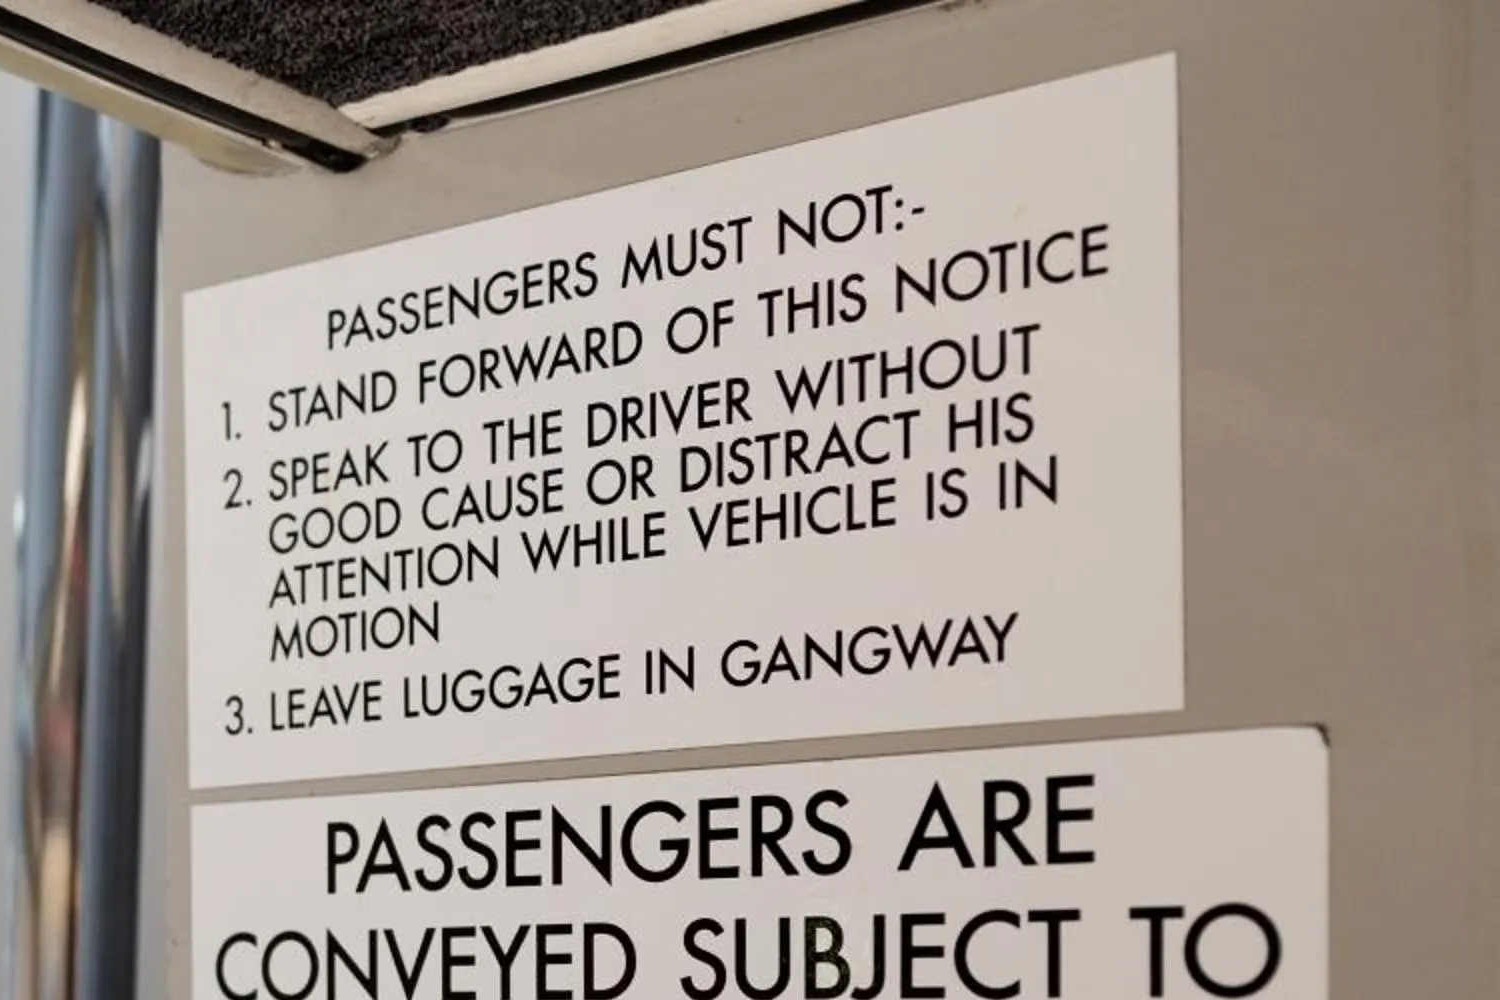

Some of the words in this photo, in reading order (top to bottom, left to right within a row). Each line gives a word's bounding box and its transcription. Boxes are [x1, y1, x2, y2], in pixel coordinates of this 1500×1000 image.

[220, 401, 243, 441] 1.
[267, 369, 398, 433] STAND
[418, 319, 644, 405] FORWARD
[665, 298, 735, 356] OF
[756, 272, 868, 339] THIS
[894, 222, 1110, 314] NOTICE
[327, 250, 600, 351] PASSENGERS
[620, 214, 754, 290] MUST
[777, 183, 926, 256] NOT:-
[222, 467, 253, 510] 2.
[267, 440, 390, 502] SPEAK
[406, 428, 464, 478] TO
[482, 408, 564, 466] THE
[586, 376, 754, 450] DRIVER
[773, 322, 1042, 415] WITHOUT
[268, 496, 402, 556] GOOD
[420, 466, 565, 532] CAUSE
[585, 453, 658, 507] OR
[679, 413, 922, 494] DISTRACT
[947, 390, 1035, 454] HIS
[268, 534, 500, 610] ATTENTION
[519, 510, 667, 574] WHILE
[686, 476, 897, 552] VEHICLE
[925, 466, 970, 522] IS
[998, 454, 1058, 512] IN
[223, 694, 254, 737] 3.
[270, 679, 383, 732] LEAVE
[402, 652, 622, 719] LUGGAGE
[644, 644, 696, 696] IN
[719, 611, 1020, 688] GANGWAY
[269, 600, 440, 663] MOTION
[326, 788, 854, 896] PASSENGERS
[896, 773, 1097, 873] ARE
[1127, 901, 1283, 1000] TO
